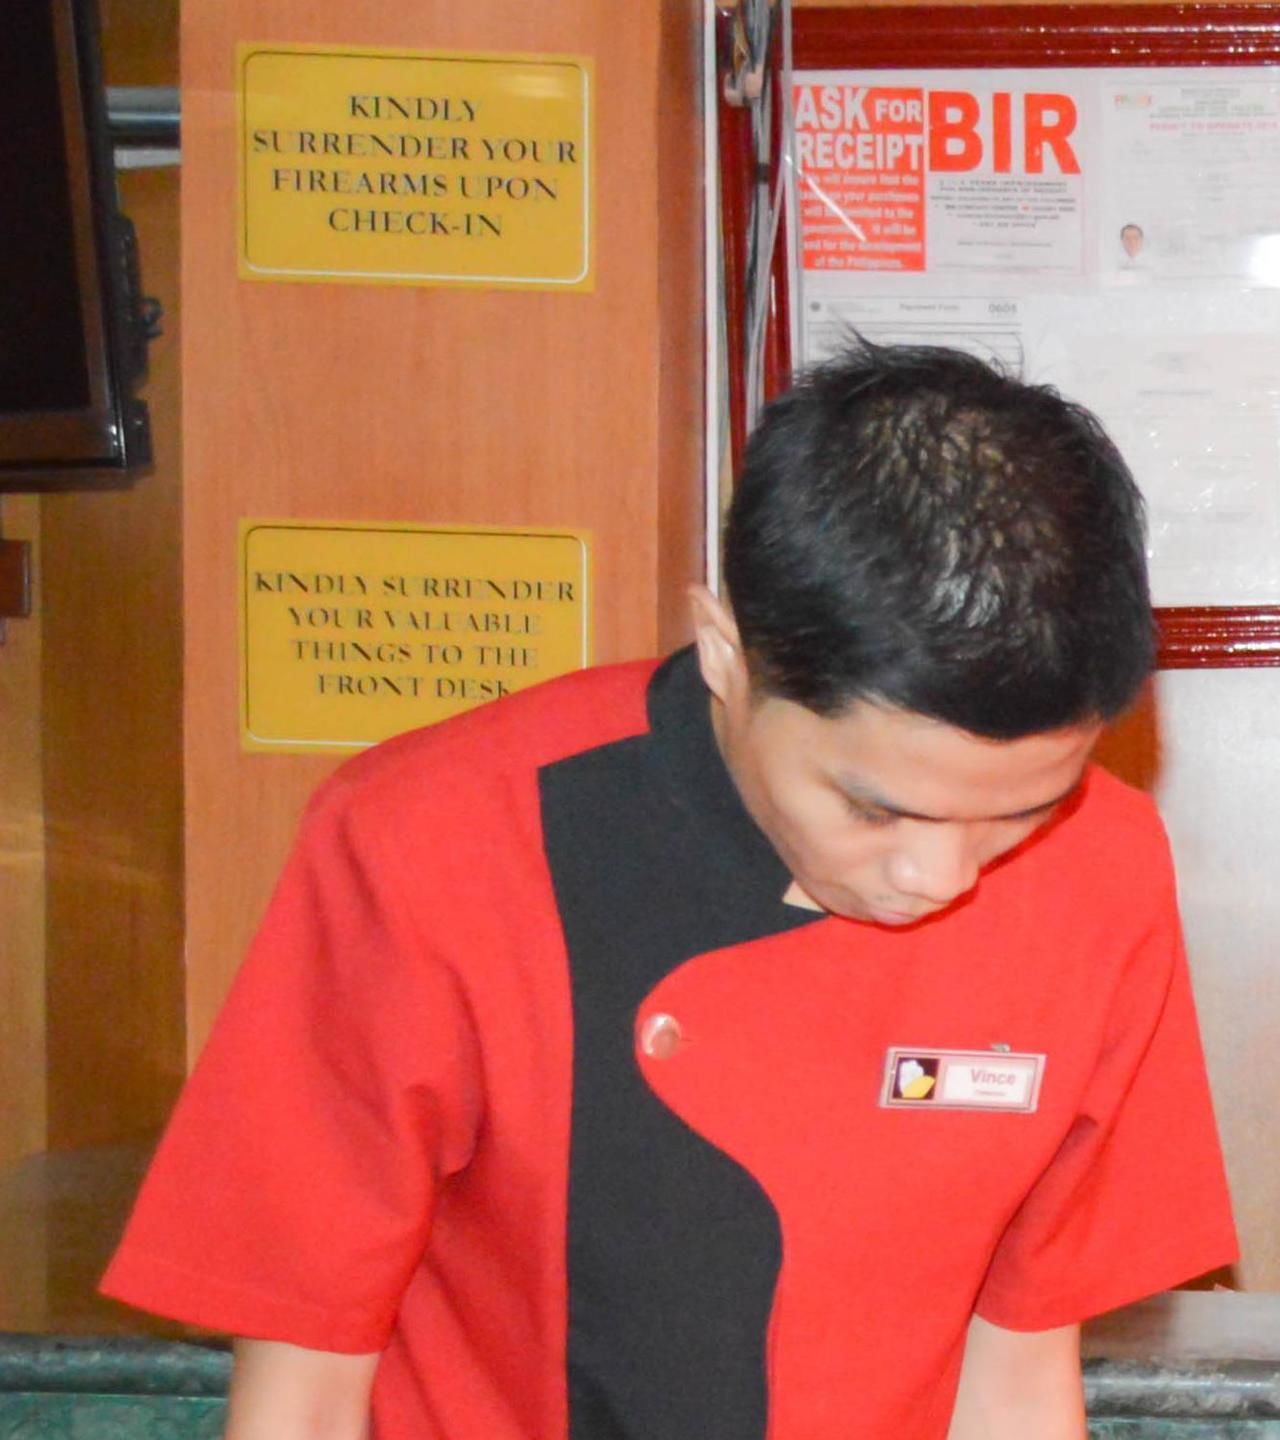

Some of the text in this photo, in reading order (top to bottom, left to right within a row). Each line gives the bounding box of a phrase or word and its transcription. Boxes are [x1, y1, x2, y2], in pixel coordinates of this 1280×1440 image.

[349, 95, 484, 122] KINDLY
[795, 88, 922, 130] ASK FOR
[252, 131, 578, 163] SURRENDER YOUR
[929, 91, 1081, 174] BIR
[797, 133, 923, 170] RECEIPT
[271, 170, 559, 200] FIREARMS UPON
[328, 209, 503, 238] CHECK-IN
[254, 572, 575, 602] KINDLY SURRENDER
[289, 608, 542, 634] YOUR VALUABLE
[291, 640, 540, 667] THINGS TO THE
[317, 675, 514, 700] FRONT DESK
[970, 1068, 1016, 1085] Vince
